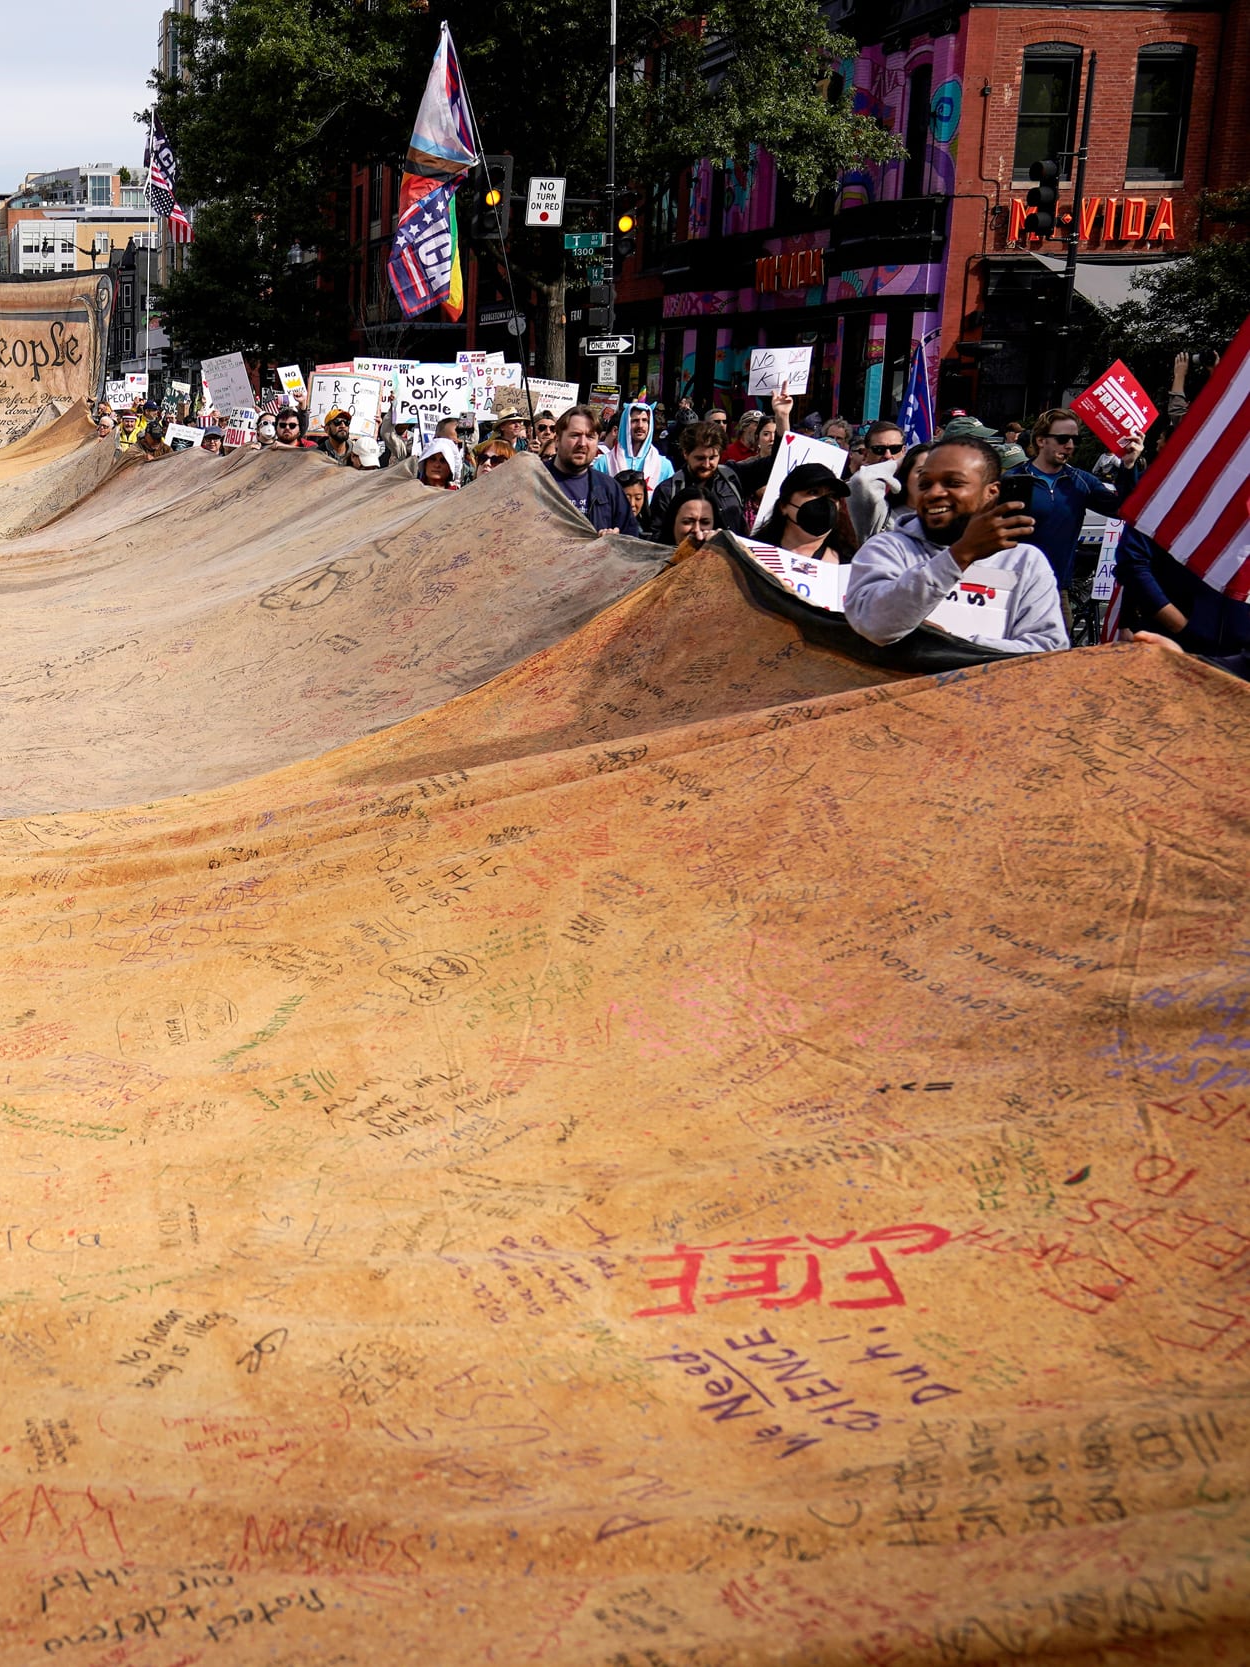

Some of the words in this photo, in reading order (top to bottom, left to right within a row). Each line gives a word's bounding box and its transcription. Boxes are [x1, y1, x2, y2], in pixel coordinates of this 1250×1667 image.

[539, 182, 555, 191] NO
[536, 193, 557, 201] TURN
[544, 203, 560, 211] RED
[1077, 197, 1176, 242] VIDA
[572, 235, 581, 247] T
[573, 248, 595, 256] 1300
[776, 248, 826, 290] VIDA
[590, 342, 605, 350] ONE
[605, 342, 620, 350] WAY
[752, 354, 775, 369] NO
[406, 375, 425, 388] No
[431, 374, 469, 390] Kings
[755, 369, 807, 388] KINGS
[108, 393, 136, 404] PEOPL
[1092, 385, 1127, 421] FREE
[230, 409, 239, 418] IF
[239, 409, 256, 420] YOU
[400, 400, 452, 416] People
[645, 1349, 762, 1425] Need
